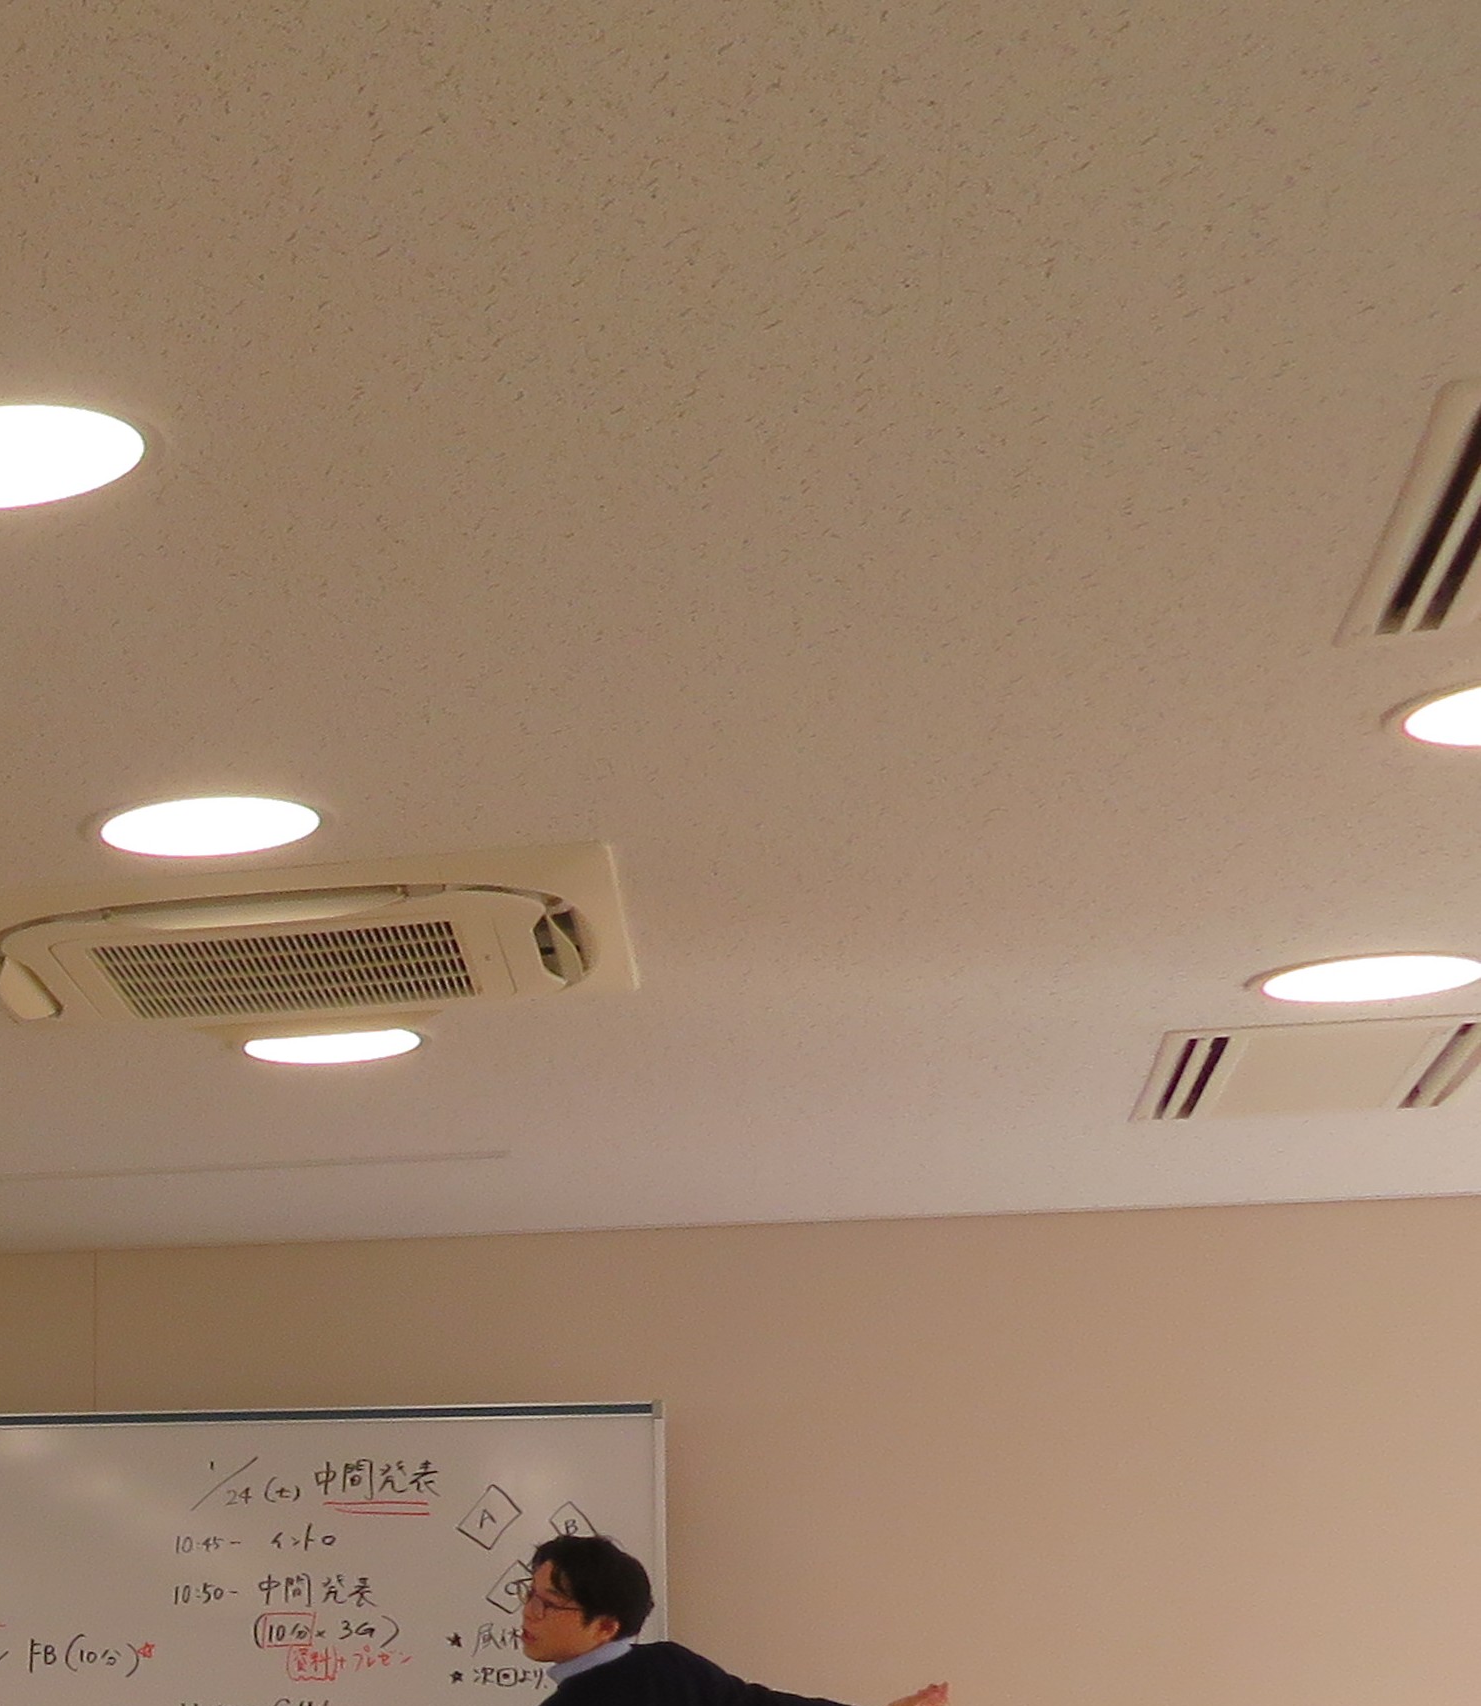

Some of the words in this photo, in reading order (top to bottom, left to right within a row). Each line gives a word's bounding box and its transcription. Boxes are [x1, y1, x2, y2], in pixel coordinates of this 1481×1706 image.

[478, 1509, 497, 1529] A
[564, 1518, 579, 1535] B
[257, 1574, 377, 1609] 中間発表
